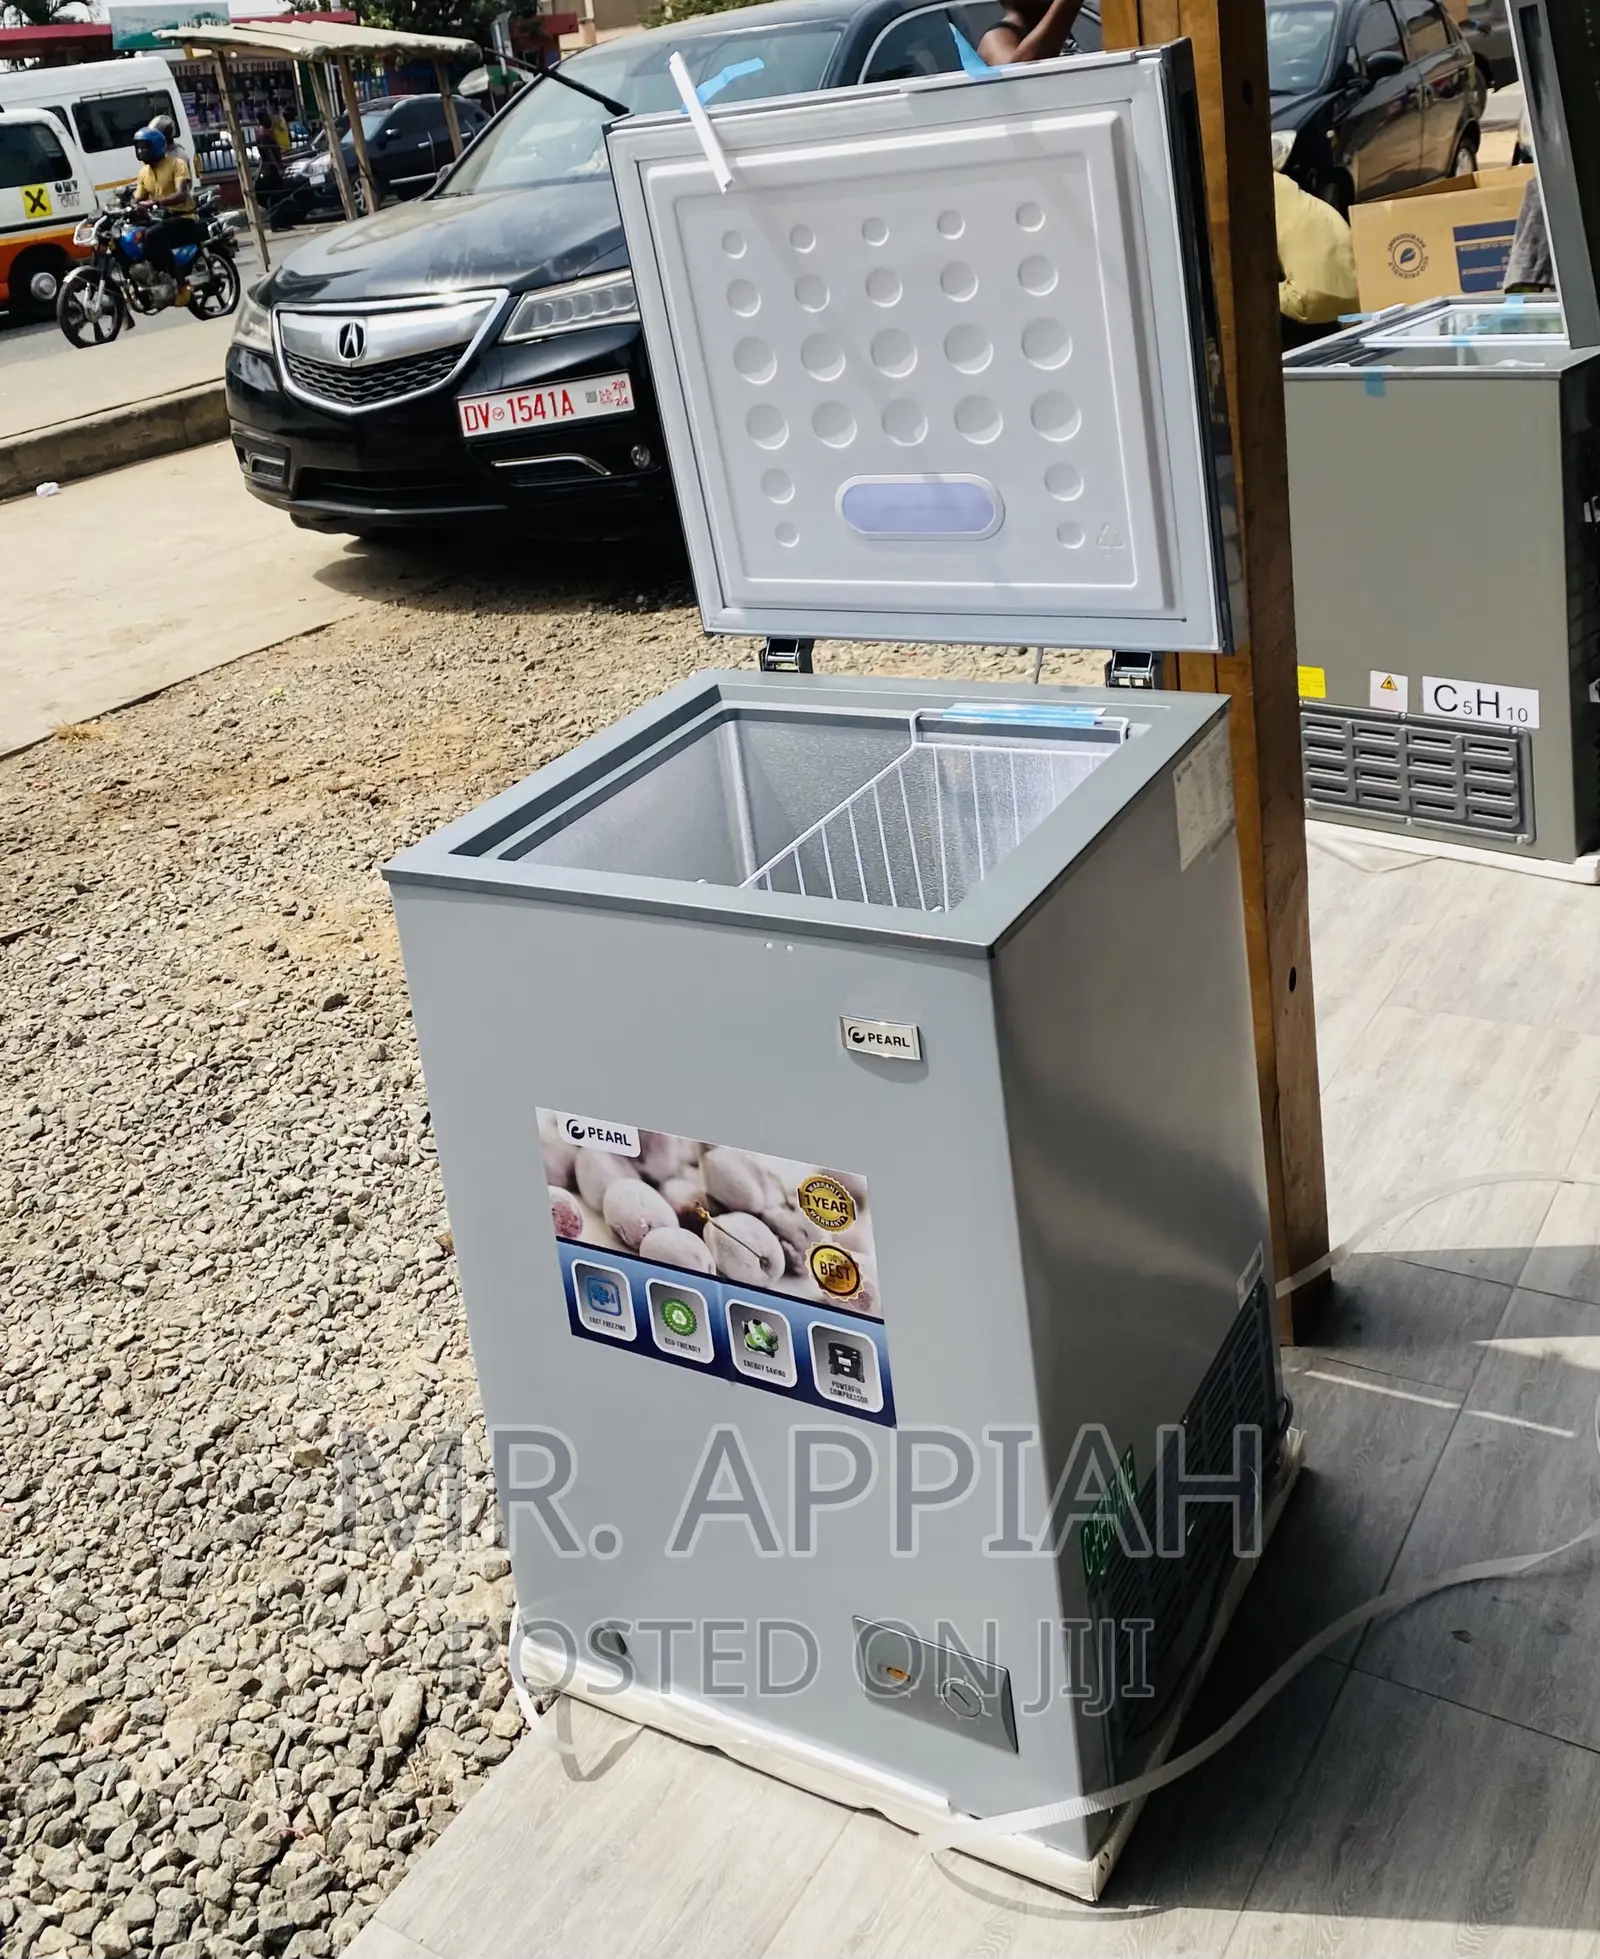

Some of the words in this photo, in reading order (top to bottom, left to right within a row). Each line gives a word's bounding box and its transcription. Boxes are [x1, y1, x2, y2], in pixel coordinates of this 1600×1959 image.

[612, 380, 626, 390] 20
[463, 402, 490, 431] DV
[506, 389, 575, 424] 1541A
[867, 1032, 910, 1048] PEARL
[587, 1126, 632, 1147] PEARL
[804, 1194, 811, 1206] 1
[812, 1195, 849, 1215] YEAR
[820, 1260, 851, 1282] BEST
